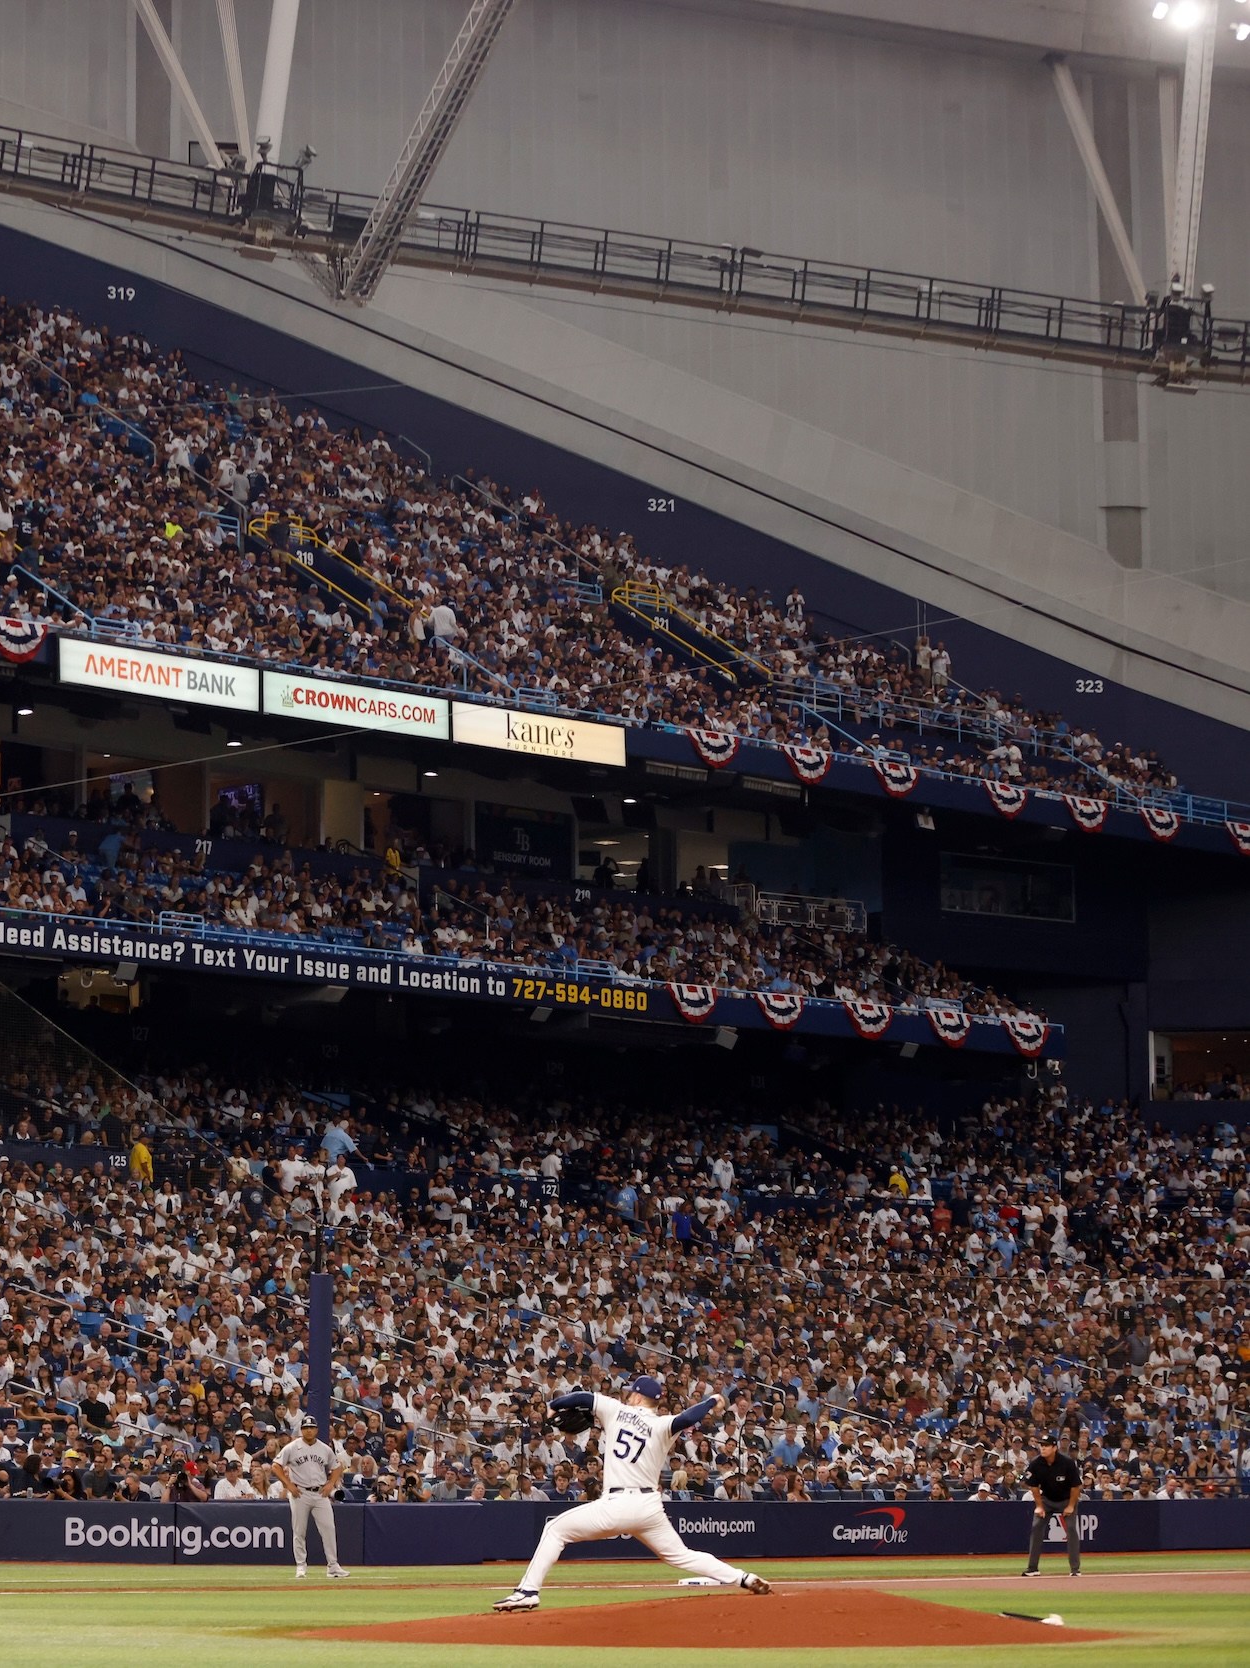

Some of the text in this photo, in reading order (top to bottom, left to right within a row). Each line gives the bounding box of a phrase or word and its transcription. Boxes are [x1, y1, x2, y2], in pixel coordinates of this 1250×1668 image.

[107, 286, 135, 301] 319
[647, 498, 675, 513] 321
[296, 550, 314, 566] 319
[85, 654, 236, 697] AMERANT BANK
[1075, 679, 1103, 694] 323
[292, 687, 436, 724] CROWNCARS.COM
[505, 712, 575, 749] kane's
[507, 742, 574, 758] FURNITURE
[195, 838, 213, 855] 217
[493, 850, 551, 868] SENSORY ROOM
[52, 927, 185, 962] Assistance?
[191, 942, 236, 969] Text
[243, 948, 289, 974] Your
[296, 954, 350, 980] Issue
[356, 963, 391, 984] and
[398, 965, 481, 994] Location
[487, 978, 506, 997] to
[512, 978, 648, 1012] 727-594-0860
[108, 1155, 127, 1167] 125
[616, 1410, 653, 1438] RASMUSSEN
[613, 1428, 646, 1464] 57
[295, 1454, 326, 1467] NEW YORK
[65, 1516, 285, 1556] Booking.com
[678, 1517, 756, 1537] Booking.com
